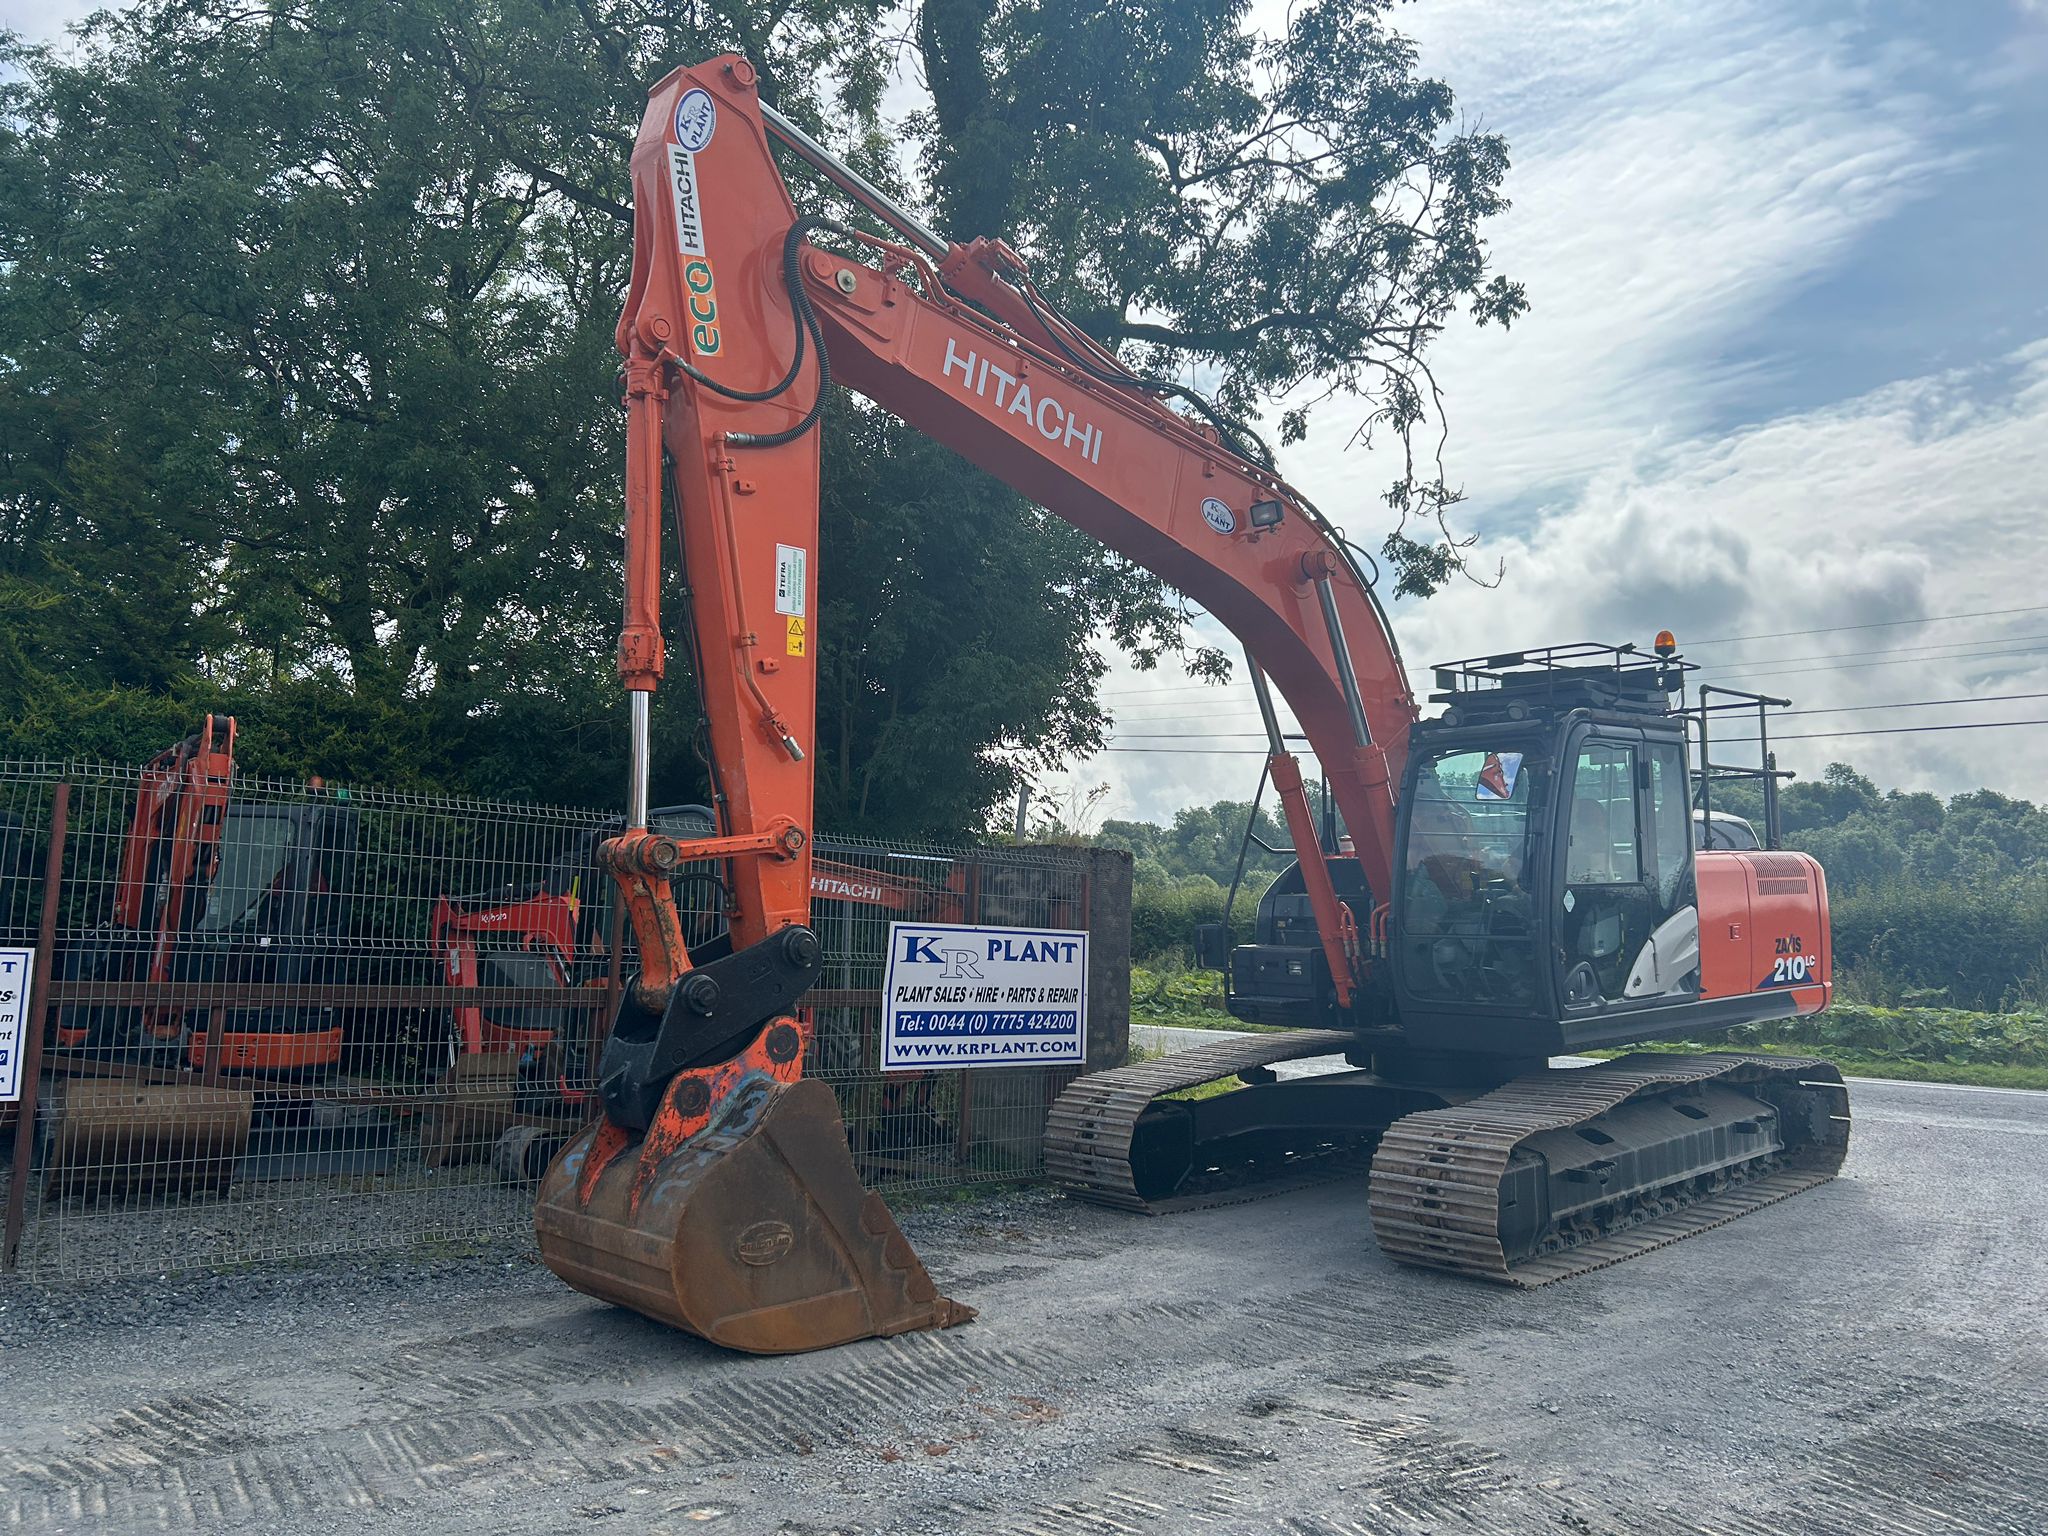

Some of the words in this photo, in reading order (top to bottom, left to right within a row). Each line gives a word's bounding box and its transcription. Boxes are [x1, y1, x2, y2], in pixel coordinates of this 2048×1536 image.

[691, 102, 710, 145] PLANT
[674, 151, 698, 249] HITACHI
[942, 338, 1103, 464] HITACHI
[1207, 511, 1230, 529] PLANT
[811, 877, 881, 900] HITACHI
[987, 939, 1078, 963] PLANT
[1775, 934, 1801, 954] ZAXIS
[895, 986, 933, 1002] PLANT
[934, 986, 967, 1002] SALES
[974, 987, 999, 1003] HIRE
[1006, 987, 1037, 1003] PARTS
[1038, 987, 1045, 1003] &
[1046, 988, 1078, 1003] REPAIR
[900, 1014, 925, 1031] Tel:
[928, 1014, 966, 1031] 0044
[969, 1014, 988, 1034] (0)
[992, 1014, 1025, 1030] 7775
[1027, 1013, 1074, 1030] 424200
[894, 1041, 1076, 1057] WWW.KRPLANT.COM
